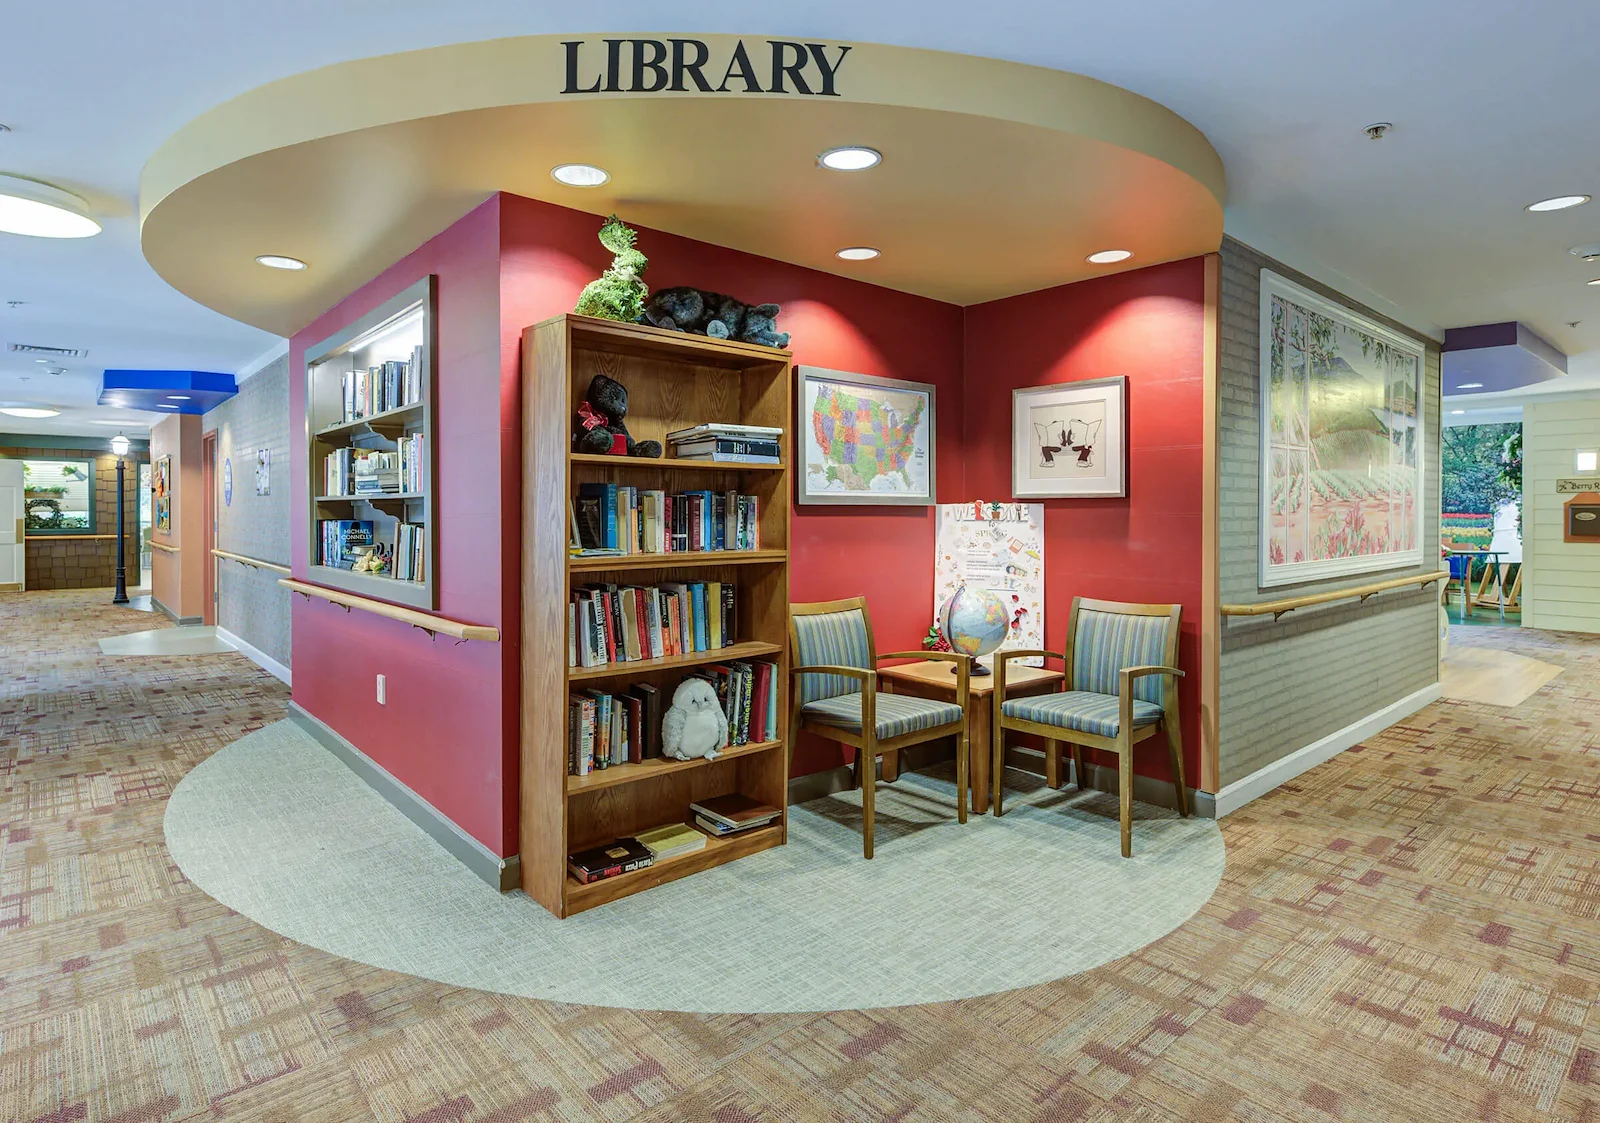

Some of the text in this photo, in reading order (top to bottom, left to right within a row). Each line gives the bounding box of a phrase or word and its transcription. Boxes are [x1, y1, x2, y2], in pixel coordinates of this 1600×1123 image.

[560, 39, 852, 97] LIBRARY
[1571, 483, 1592, 491] Berry
[953, 500, 1029, 522] WELCOME
[976, 529, 1007, 538] SPRG
